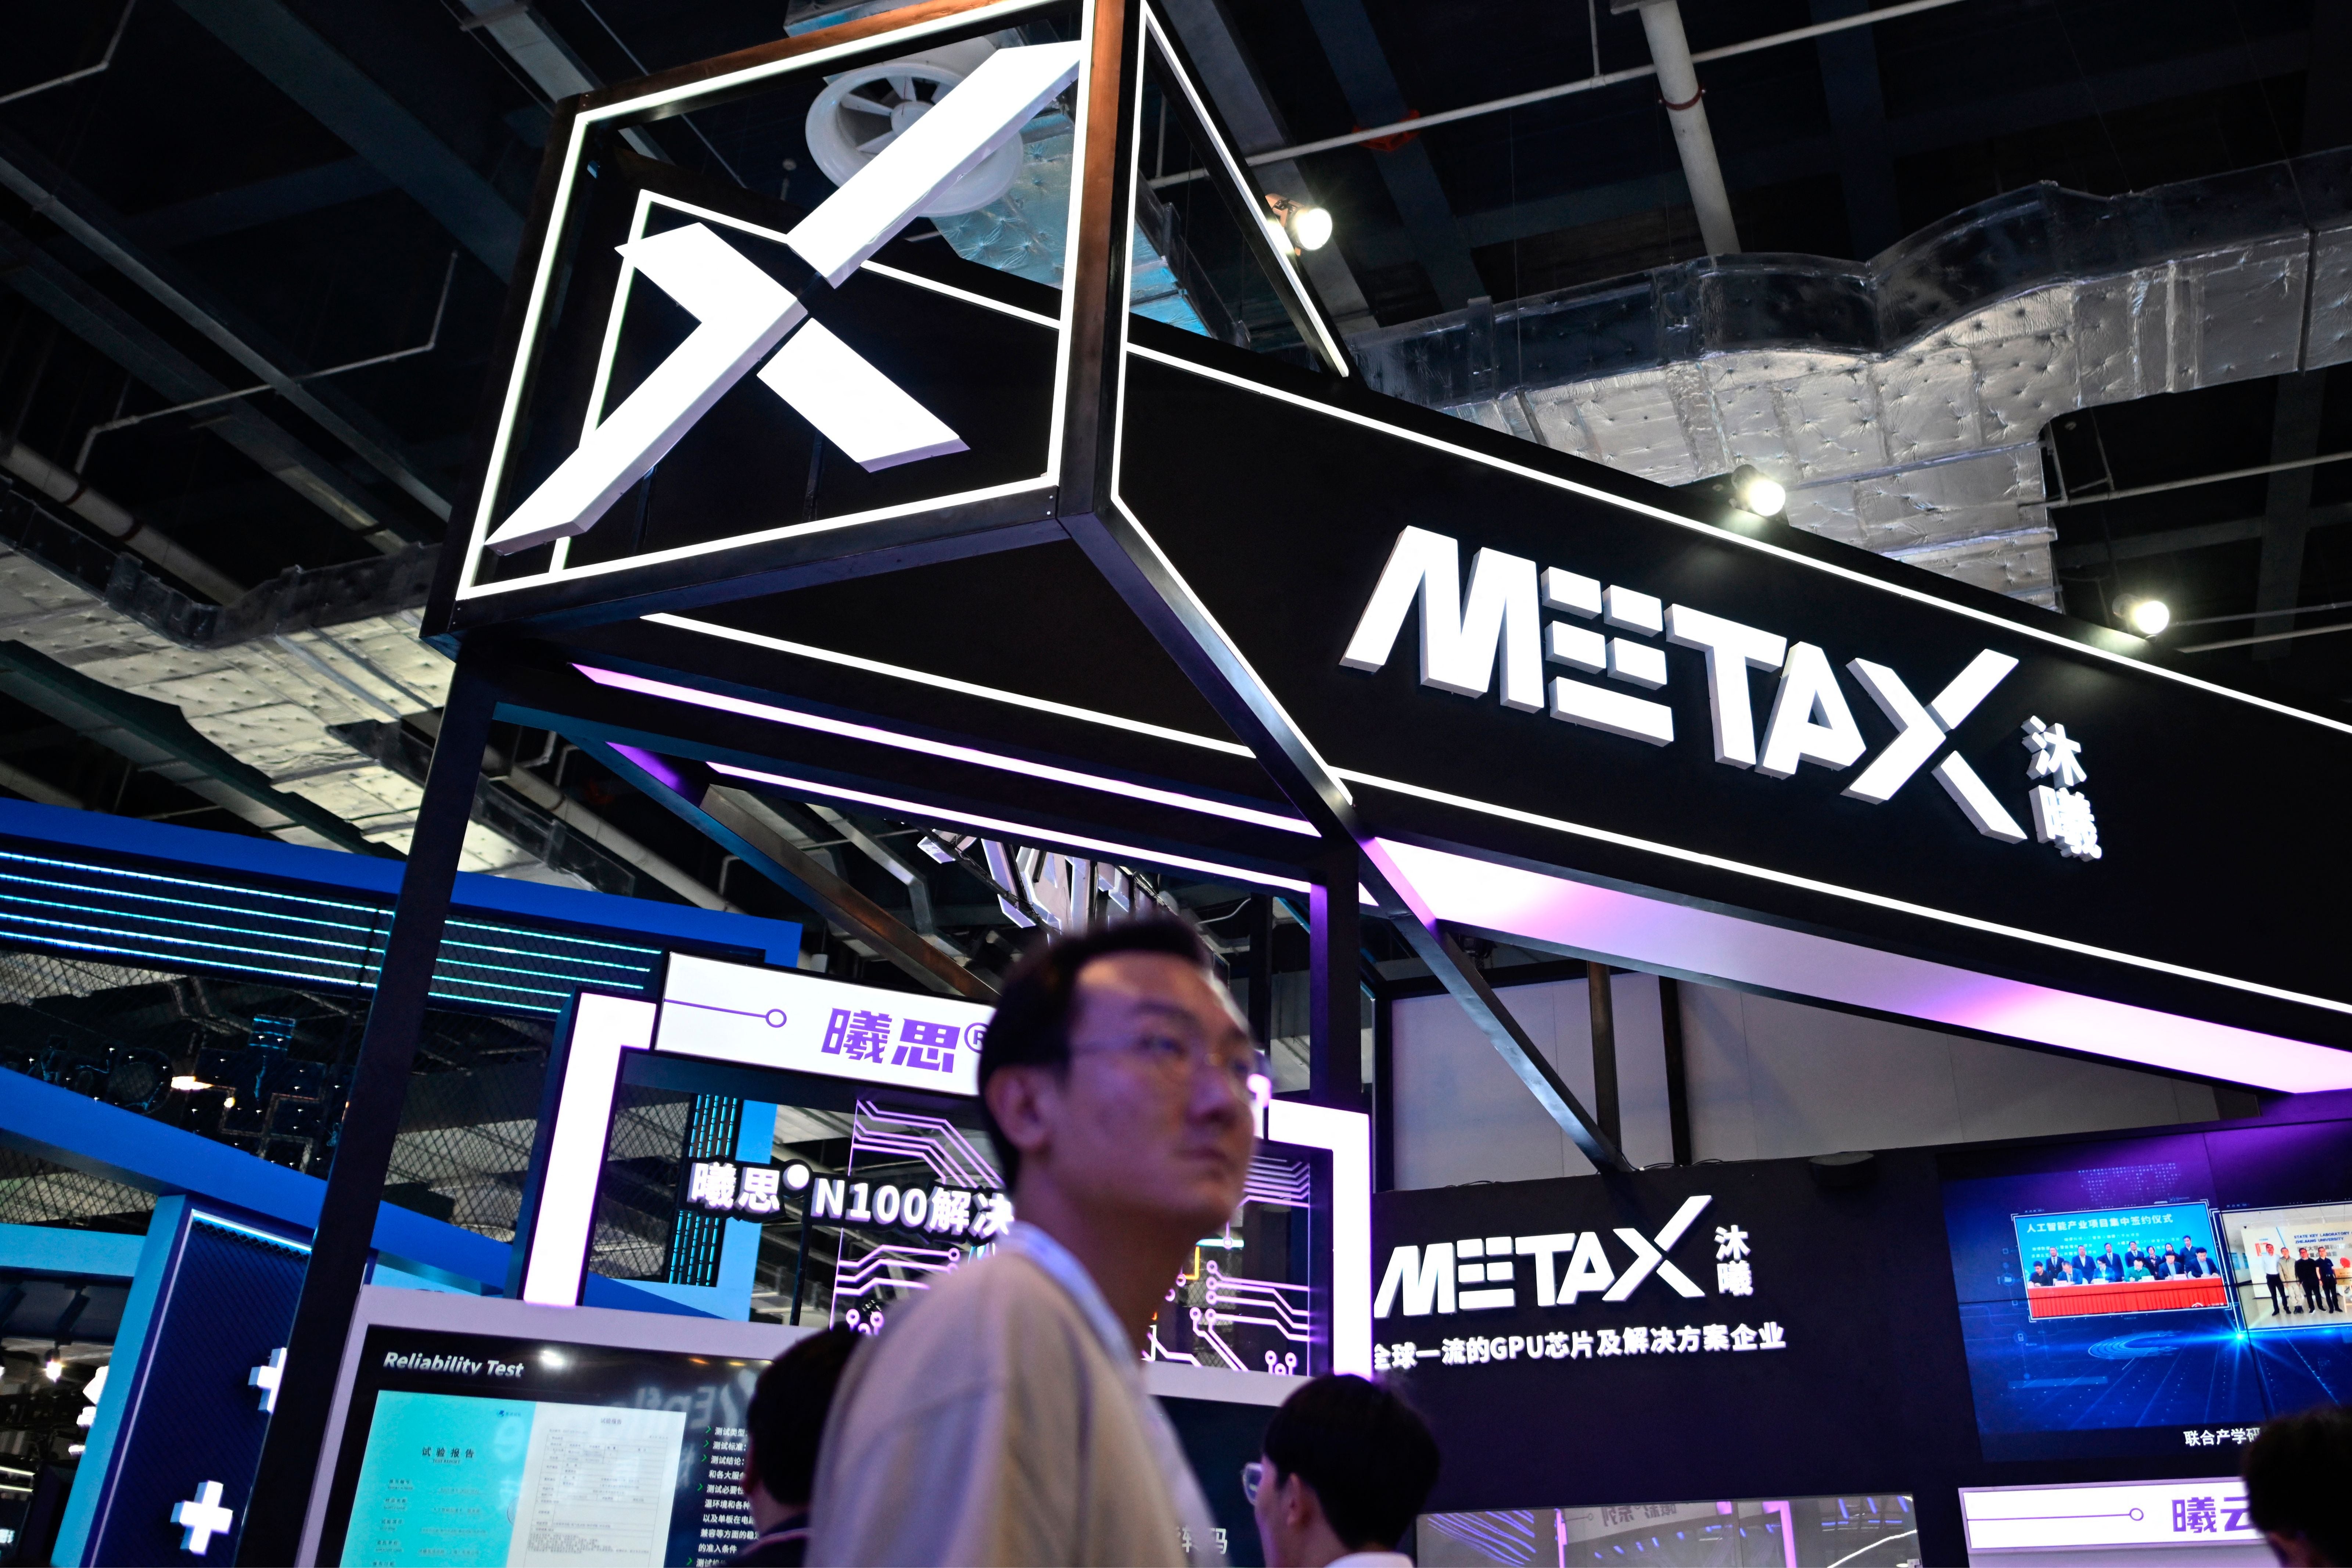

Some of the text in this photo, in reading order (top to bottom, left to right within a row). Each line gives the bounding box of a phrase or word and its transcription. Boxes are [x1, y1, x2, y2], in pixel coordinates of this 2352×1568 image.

[1339, 525, 2027, 844] METAX
[2022, 715, 2102, 861] 沐曦
[2026, 1213, 2174, 1234] 人工智能产业项目集中签约仪式
[1373, 1195, 1713, 1319] METAX
[1714, 1224, 1754, 1296] 沐曦
[383, 1351, 524, 1378] Reliability Test
[1373, 1321, 1786, 1371] 全球一流的GPU芯片及解决方案企业
[421, 1446, 474, 1458] 试验报告
[2172, 1496, 2255, 1533] 曦云
[698, 1543, 737, 1555] 的准入条件
